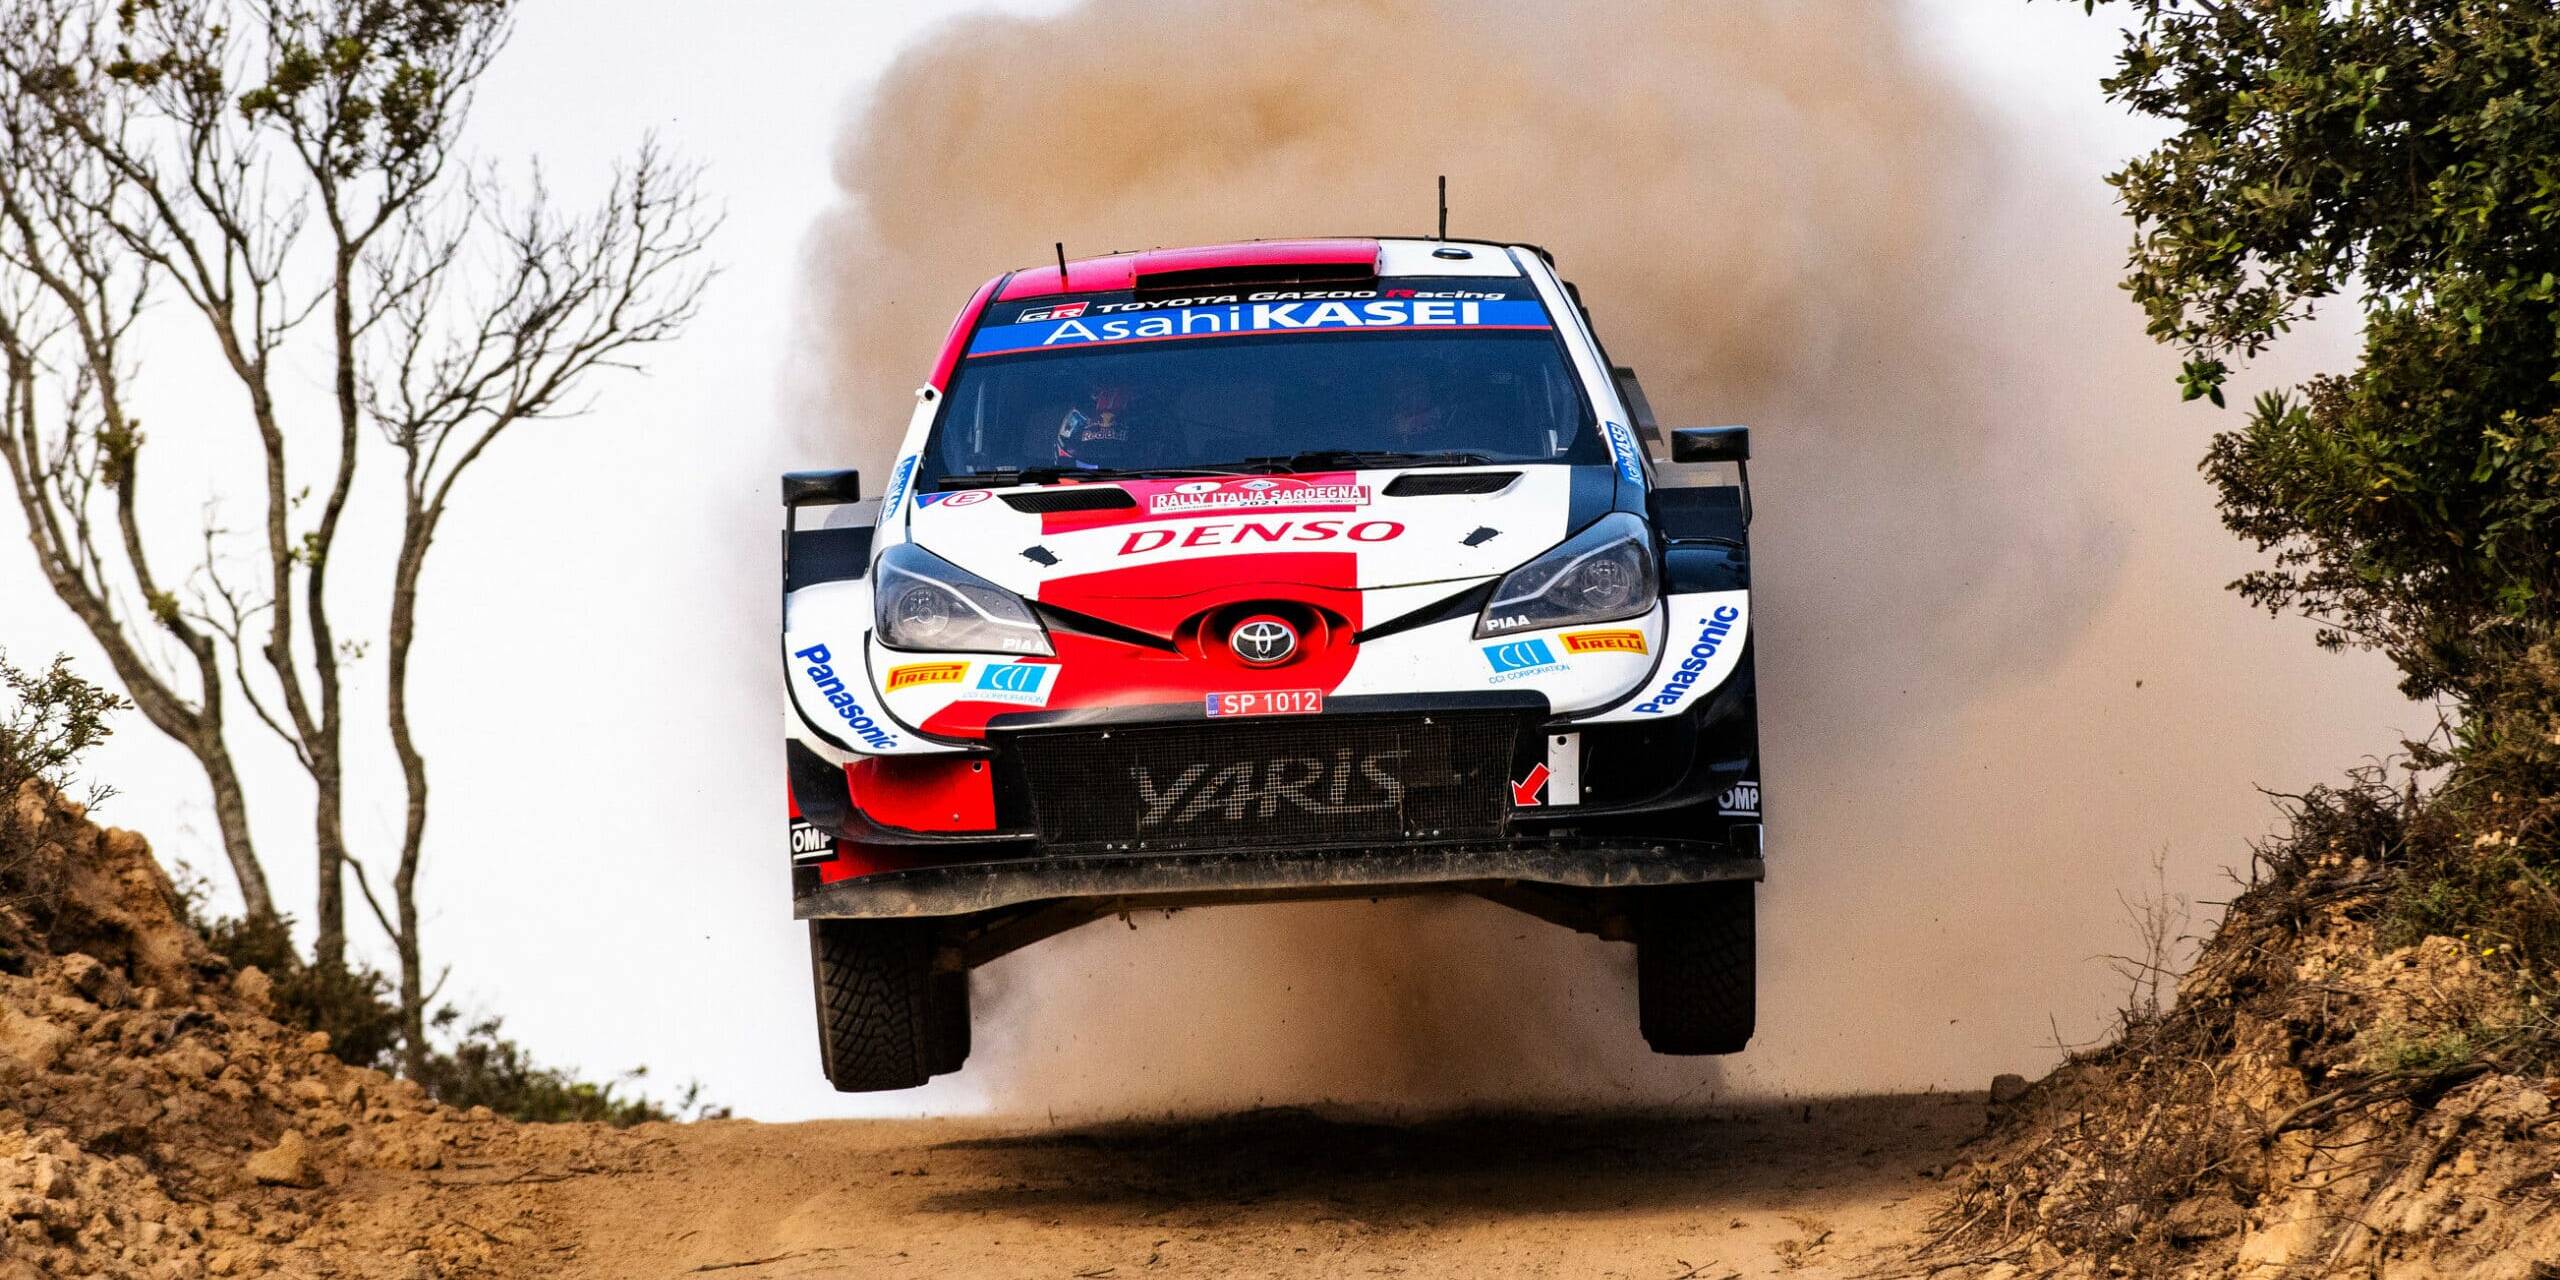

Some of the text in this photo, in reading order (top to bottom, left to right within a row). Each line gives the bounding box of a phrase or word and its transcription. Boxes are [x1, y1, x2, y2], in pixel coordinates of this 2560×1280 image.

[1097, 289, 1506, 313] TOYOTA GAZOO Racing
[1020, 308, 1082, 322] GR
[1156, 493, 1208, 508] RALLY
[1212, 490, 1266, 503] ITALIA
[1271, 486, 1362, 500] SARDEGNA
[1118, 521, 1405, 556] DENSO
[1486, 615, 1531, 630] PIAA
[1002, 638, 1043, 650] PIAA
[1566, 632, 1643, 650] PIRELLI
[1632, 605, 1739, 713] Panasonic
[889, 664, 964, 688] PIRELLI
[1507, 665, 1571, 680] CORPORATION
[795, 643, 898, 750] Panasonic
[1224, 692, 1317, 714] SP 1012
[1129, 748, 1411, 825] YARIS
